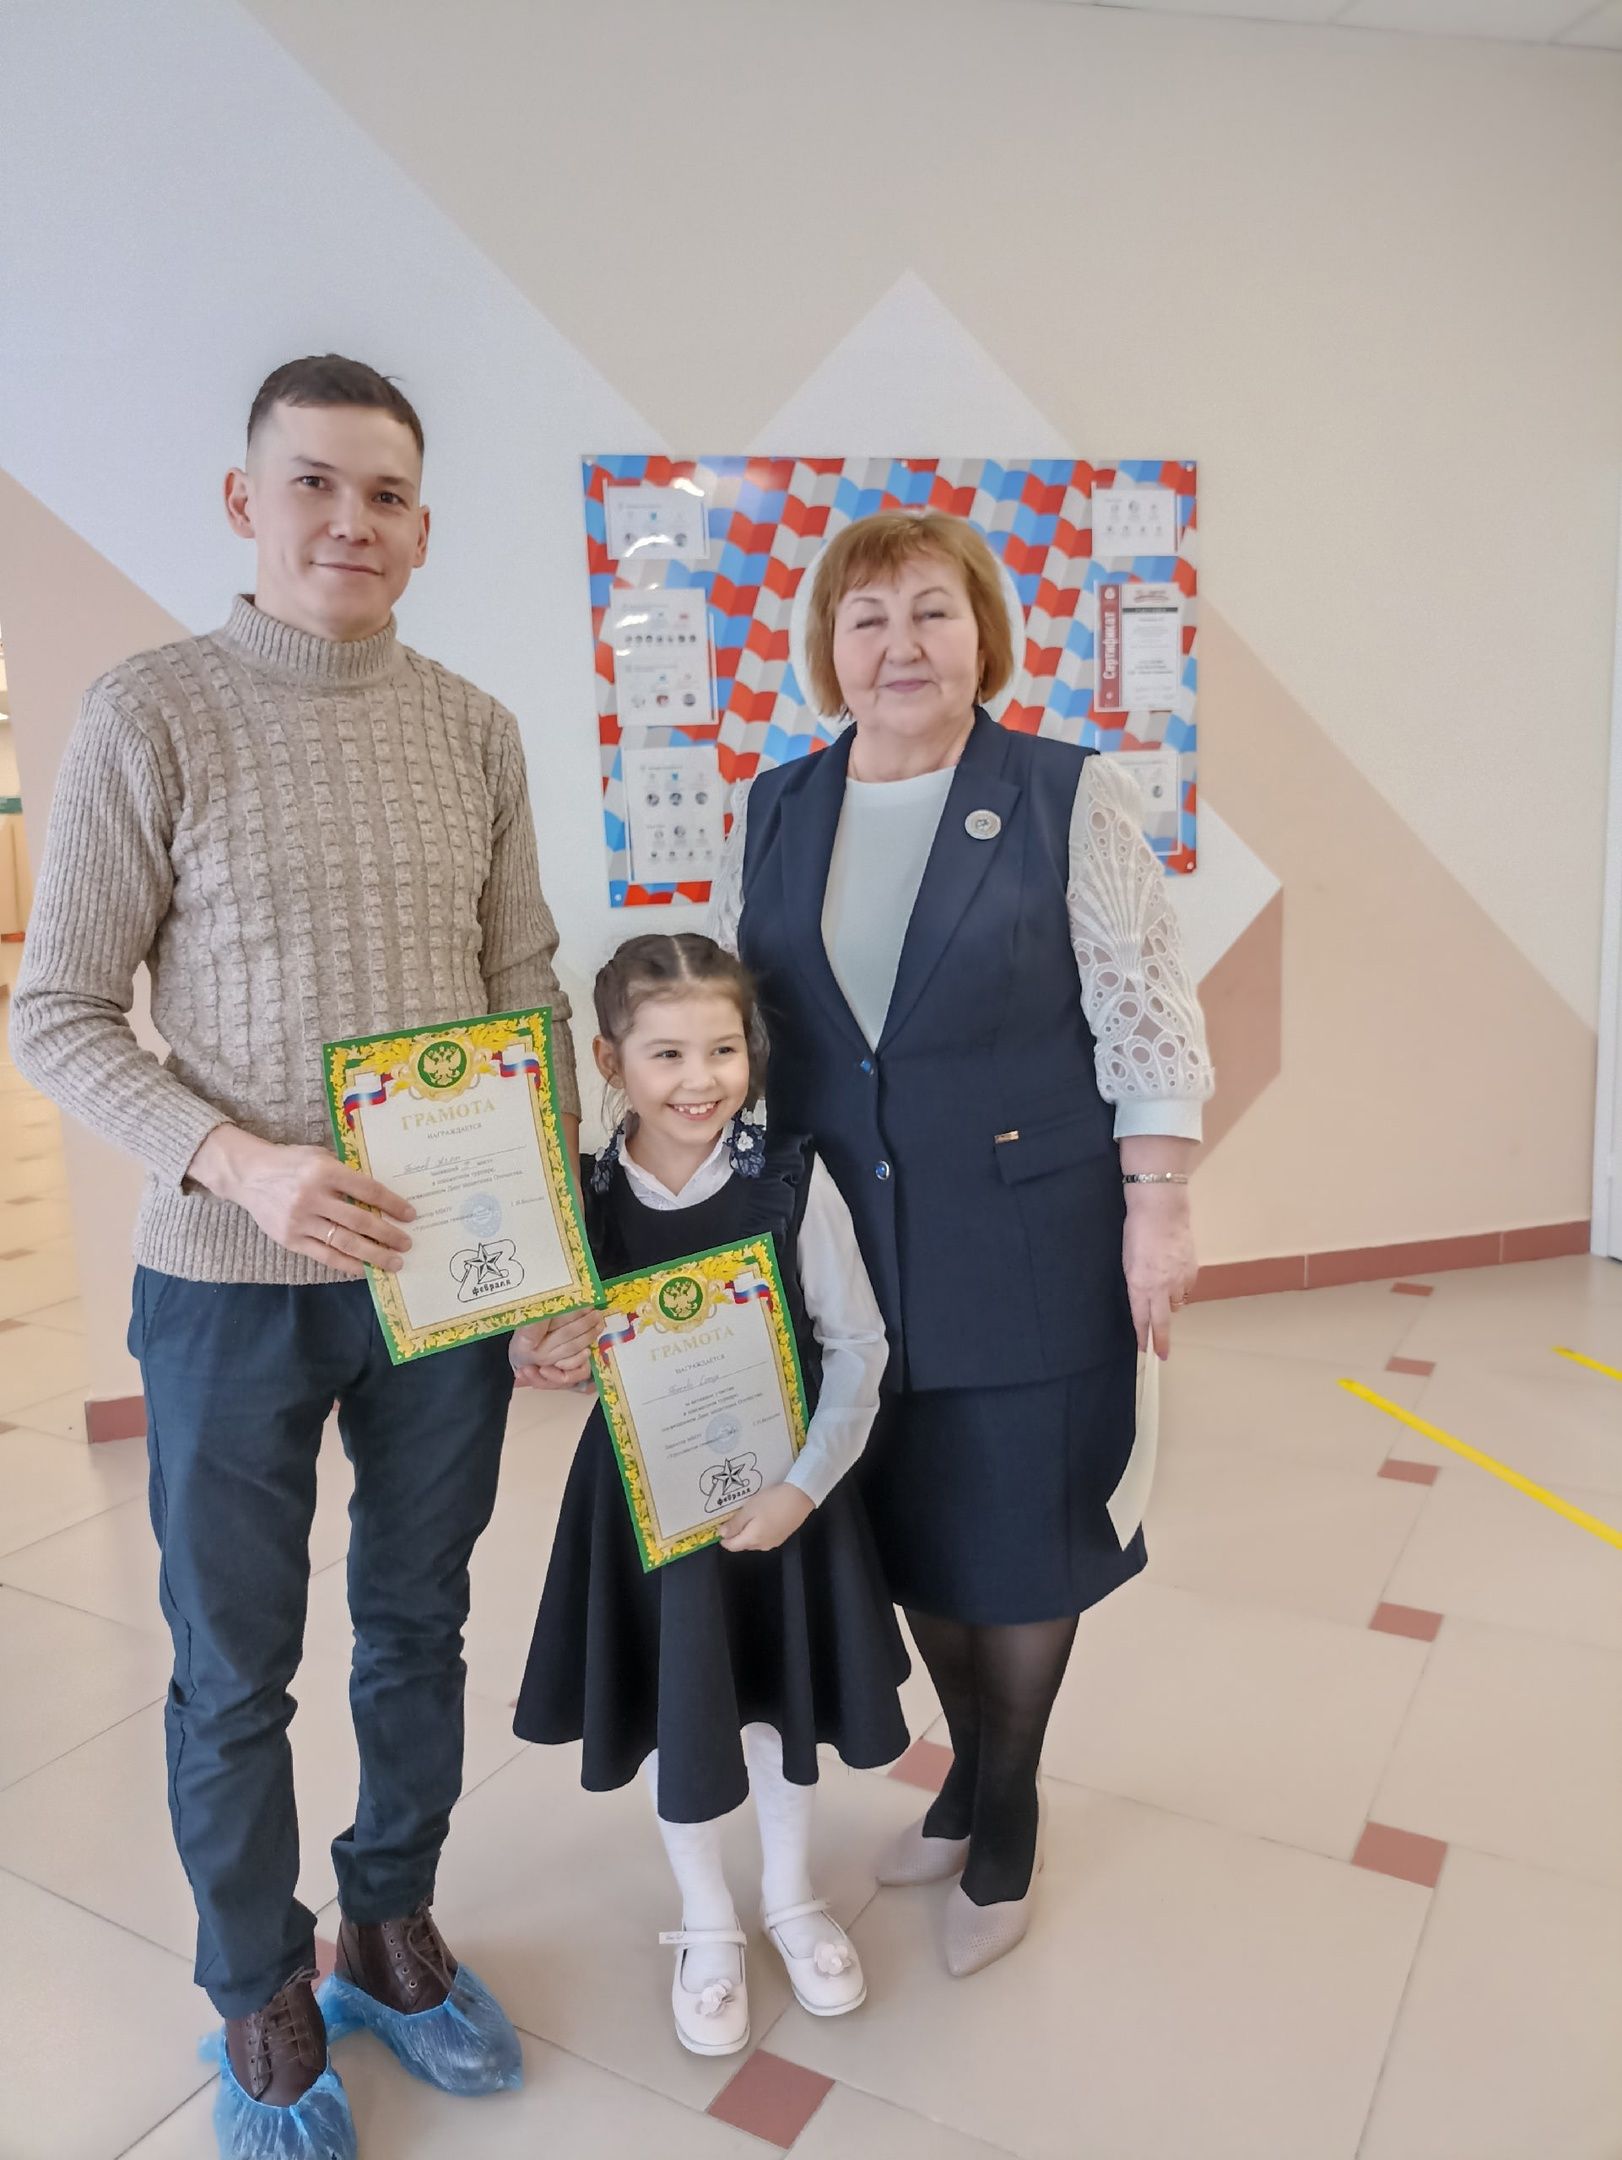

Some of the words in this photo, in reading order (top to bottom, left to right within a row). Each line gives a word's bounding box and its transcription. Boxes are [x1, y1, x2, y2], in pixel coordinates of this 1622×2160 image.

[401, 1099, 496, 1132] ГРАМОТА
[472, 1279, 512, 1297] февраля
[650, 1326, 735, 1362] ГРАМОТА
